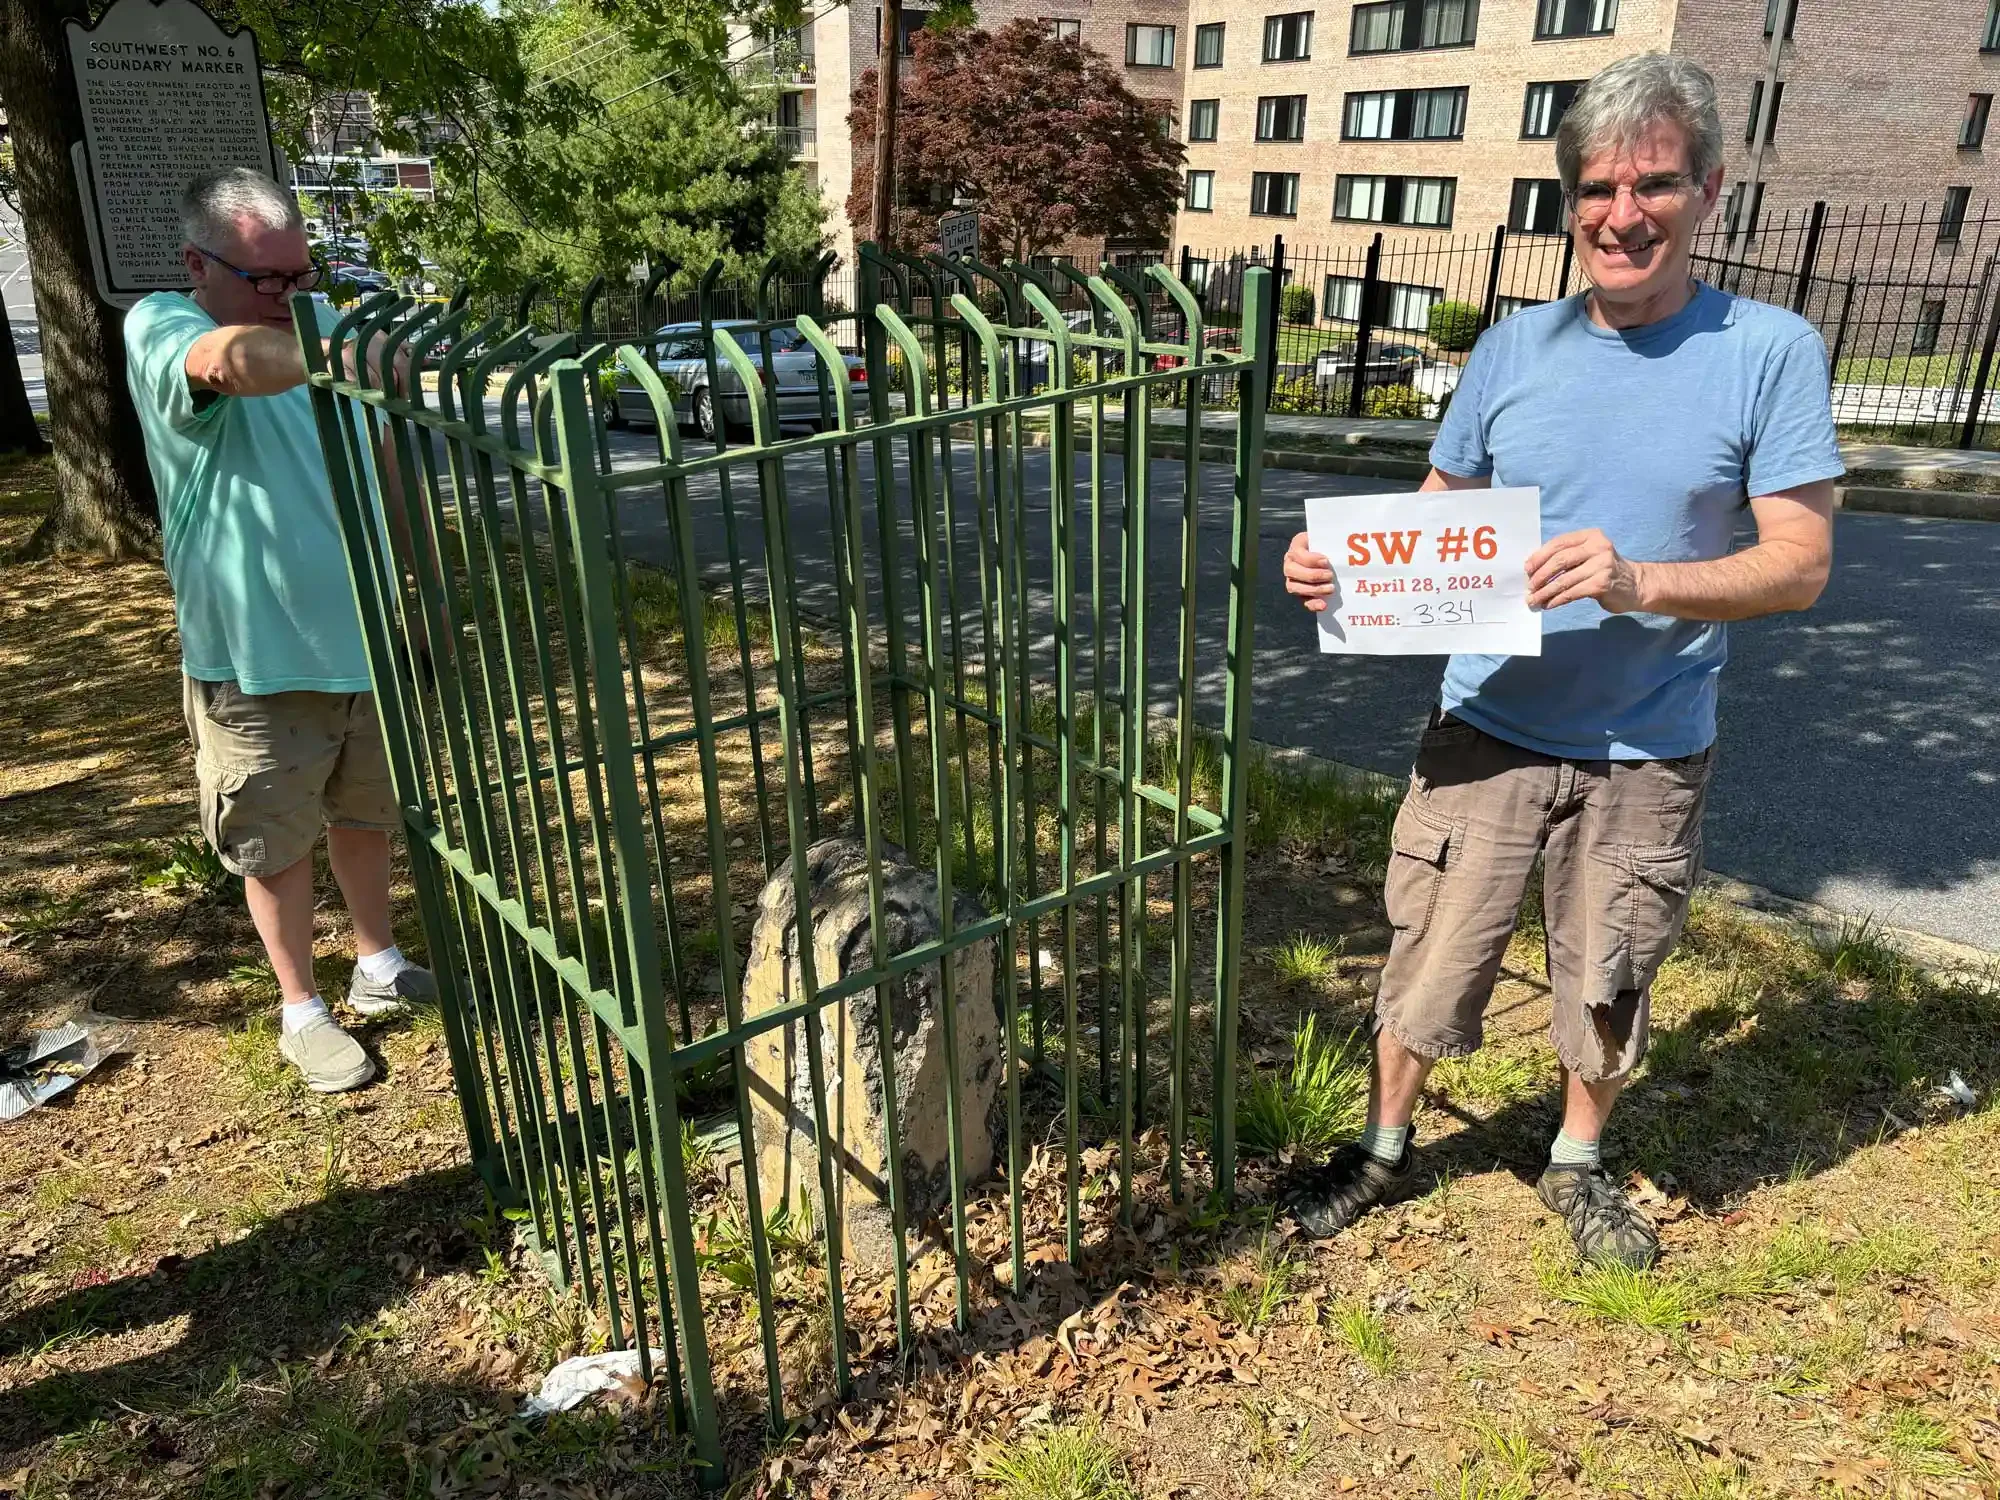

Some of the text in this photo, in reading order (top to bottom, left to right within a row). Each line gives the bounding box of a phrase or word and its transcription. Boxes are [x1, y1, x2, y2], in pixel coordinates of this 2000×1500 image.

[90, 41, 235, 57] SOUTHWEST NO. 6
[86, 58, 244, 74] BOUNDARY MARKER
[195, 82, 235, 90] ERECTED
[88, 88, 148, 97] SANDSTONE
[212, 91, 226, 99] ON
[88, 97, 149, 105] BOUNDARIES
[196, 100, 236, 108] DISTRICT
[91, 107, 142, 115] COLUMBIA
[92, 116, 144, 125] BOUNDARY
[111, 126, 159, 134] PRESIDENT
[202, 127, 258, 135] WASHINGTON
[119, 135, 162, 143] EXECUTED
[98, 143, 118, 151] WHO
[124, 144, 162, 152] BECAME
[136, 153, 168, 161] UNITED
[105, 189, 152, 197] FULFILLED
[107, 198, 148, 206] CLAUSE
[944, 220, 976, 236] SPEED
[949, 233, 972, 248] LIMIT
[116, 242, 135, 250] AND
[1347, 525, 1498, 566] SW #6
[1355, 574, 1494, 597] April 28, 2024
[1348, 599, 1476, 627] TIME: 3:34
